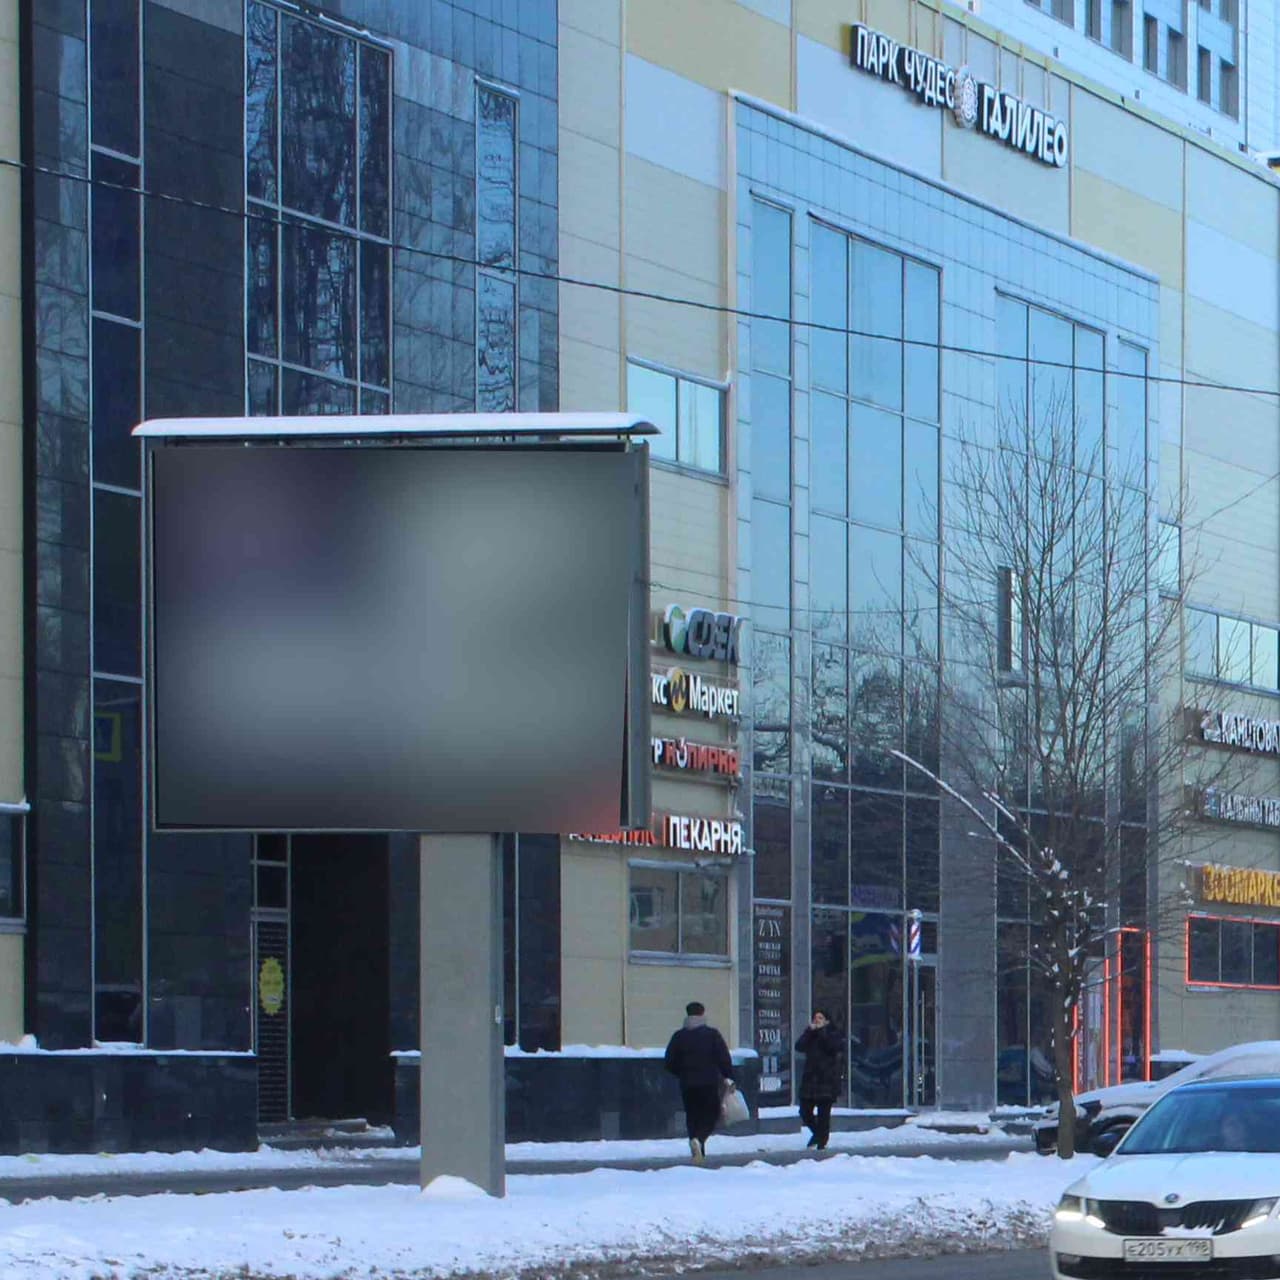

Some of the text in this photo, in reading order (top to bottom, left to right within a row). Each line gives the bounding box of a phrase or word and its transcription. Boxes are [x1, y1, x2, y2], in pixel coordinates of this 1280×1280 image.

[857, 26, 1068, 168] ПАРК ЧУДЕС ГАЛИЛЕО
[689, 674, 739, 719] Маркет
[669, 815, 742, 855] ПЕКАРНЯ
